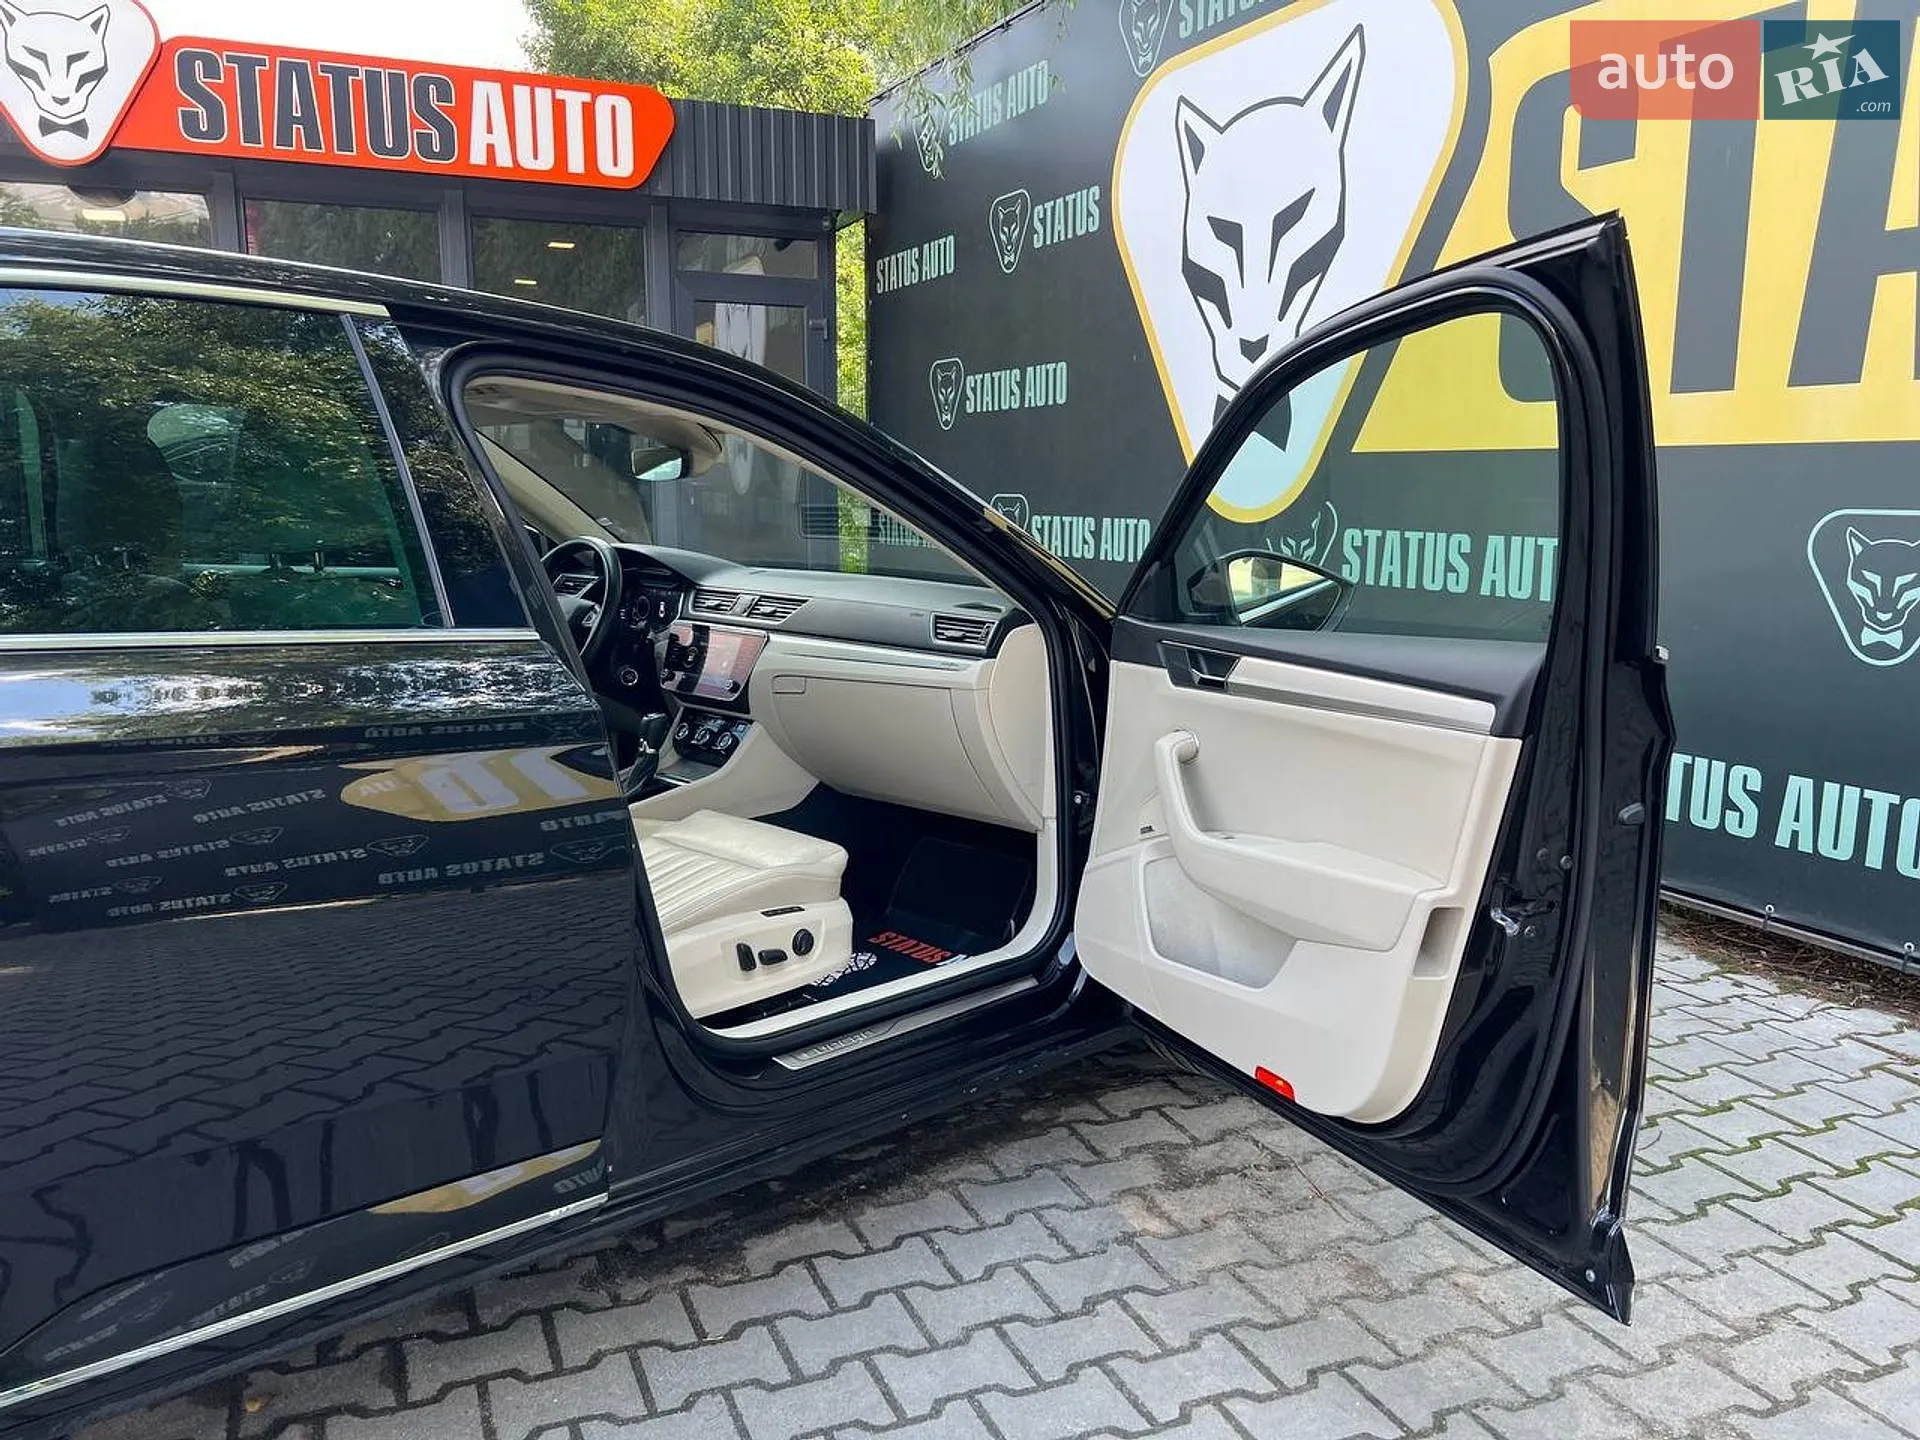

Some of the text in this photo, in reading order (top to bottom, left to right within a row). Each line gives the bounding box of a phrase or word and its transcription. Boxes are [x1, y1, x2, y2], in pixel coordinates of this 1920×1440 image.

[174, 47, 635, 178] STATUS AUTO
[1006, 60, 1049, 120] AUTO
[1032, 185, 1101, 249] STATUS
[875, 234, 955, 294] STATUS AUTO
[965, 361, 1068, 414] STATUS AUTO
[1031, 514, 1151, 562] STATUS AUTO
[1341, 527, 1471, 594] STATUS
[867, 930, 953, 965] STATUS
